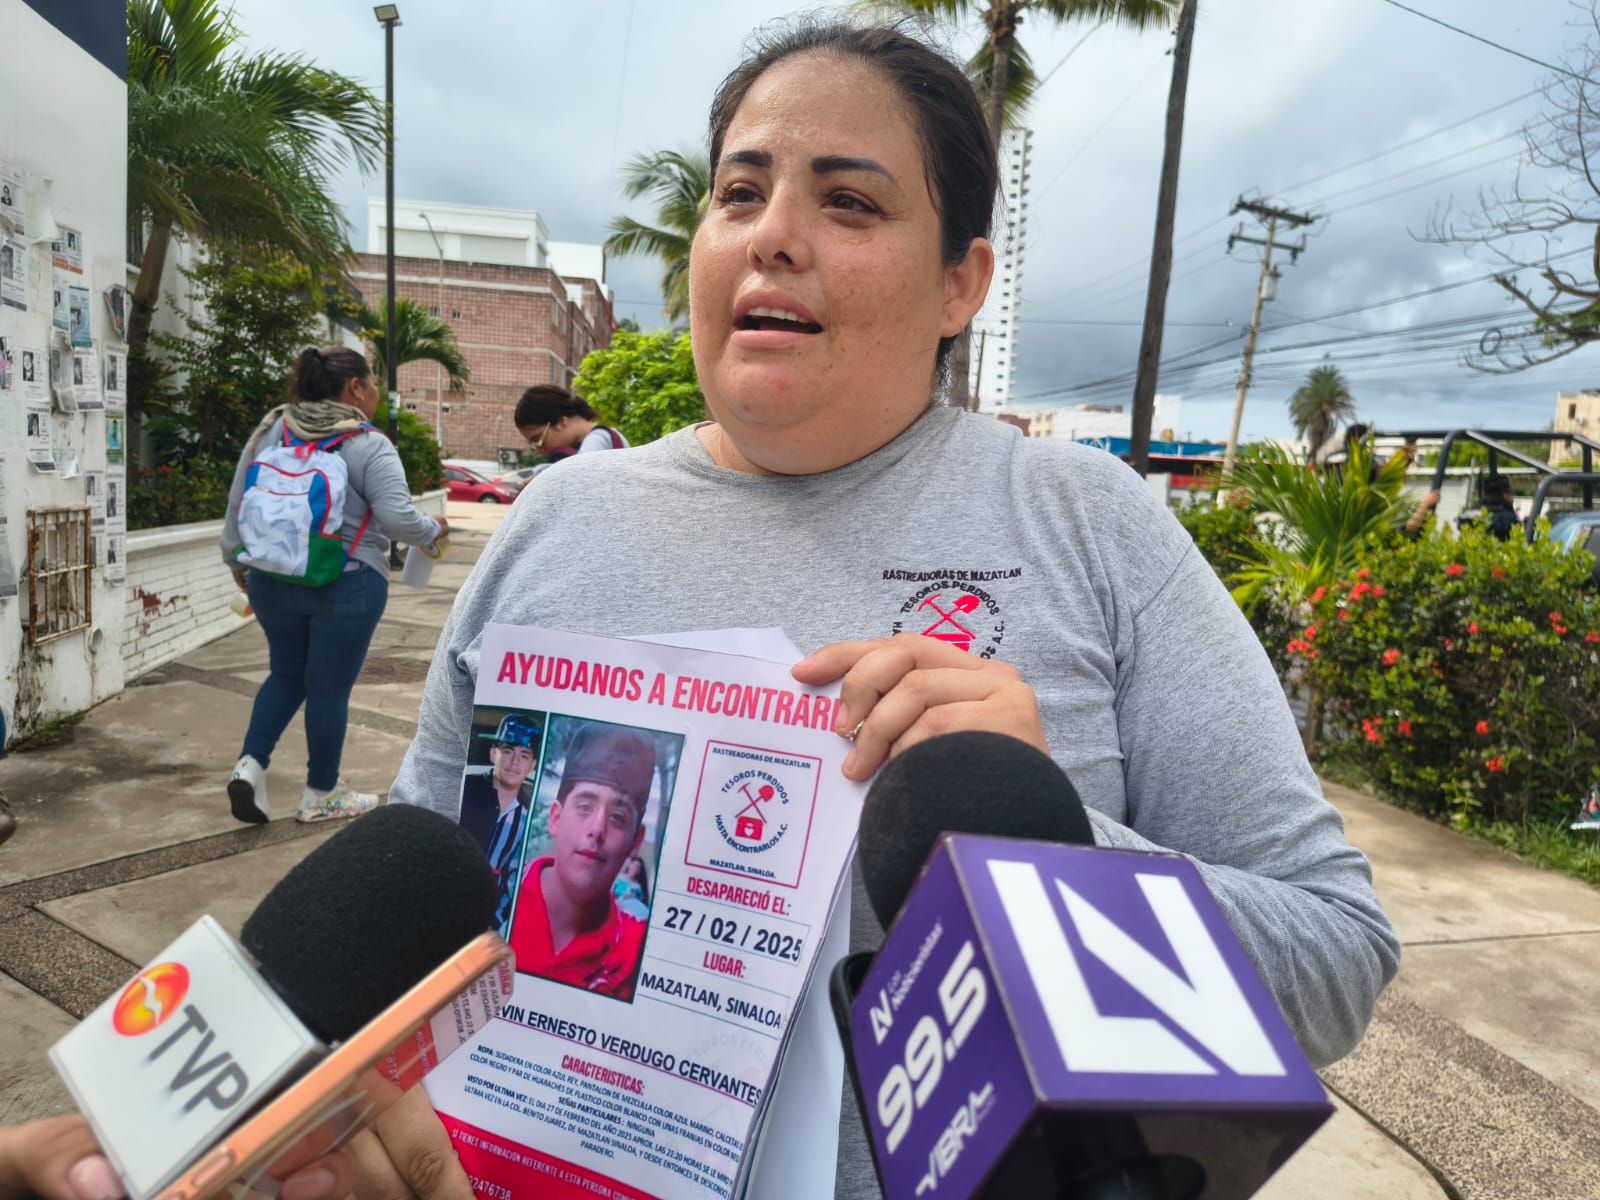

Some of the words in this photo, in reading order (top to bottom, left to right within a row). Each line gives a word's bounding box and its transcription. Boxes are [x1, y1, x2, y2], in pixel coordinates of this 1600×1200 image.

[883, 570, 955, 582] RASTREADORAS
[957, 570, 968, 581] DE
[970, 568, 1022, 581] MAZATLAN
[900, 581, 949, 614] TESOROS
[952, 581, 1000, 615] PERDIDOS
[497, 651, 644, 701] AYUDANOS
[647, 674, 665, 706] A
[712, 747, 764, 762] RASTREADORAS
[764, 755, 774, 764] DE
[774, 757, 811, 769] MAZATLAN
[721, 769, 756, 793] TESOROS
[757, 770, 789, 805] PERDIDOS
[715, 814, 729, 840] HASTA
[726, 835, 780, 854] ENCONTRARLOS
[687, 876, 770, 911] DESAPARECIÓ
[772, 896, 792, 916] EL:
[664, 906, 693, 931] 27
[695, 913, 706, 935] /
[710, 917, 737, 944] 02
[740, 925, 752, 946] /
[753, 929, 803, 962] 2025
[703, 951, 746, 978] LUGAR:
[641, 972, 722, 1012] MAZATLAN,
[725, 997, 782, 1029] SINALOA
[150, 1003, 249, 1114] TVP
[496, 1005, 525, 1023] VIN
[527, 1011, 597, 1047] ERNESTO
[604, 1036, 675, 1073] VERDUGO
[676, 1060, 762, 1104] CERVANTES
[562, 1055, 643, 1094] CARACTERISTICAS:
[877, 939, 988, 1155] 99.5
[470, 1053, 488, 1064] COLOR
[489, 1060, 508, 1072] NEGRO
[511, 1068, 523, 1077] PAR
[523, 1072, 531, 1080] DE
[532, 1076, 565, 1092] HUARACHES
[565, 1087, 574, 1095] DE
[574, 1090, 602, 1105] PLASTICO
[602, 1100, 623, 1113] COLOR
[623, 1107, 648, 1122] BLANCO
[648, 1116, 662, 1127] CON
[662, 1122, 679, 1134] UNAS
[704, 1139, 713, 1148] EN
[712, 1143, 731, 1156] COLOR
[495, 1051, 524, 1066] SUDADERA
[524, 1061, 532, 1069] EN
[532, 1064, 551, 1075] COLOR
[551, 1071, 566, 1081] AZUL
[567, 1076, 579, 1086] REY,
[580, 1080, 611, 1096] PANTALON
[612, 1091, 620, 1100] DE
[621, 1094, 652, 1111] MEZCLILLA
[653, 1106, 673, 1119] COLOR
[673, 1114, 688, 1125] AZUL
[464, 1085, 484, 1097] ULTIMA
[484, 1093, 494, 1102] VEZ
[494, 1096, 502, 1105] EN
[509, 1102, 521, 1112] COL.
[522, 1107, 544, 1121] BENITO
[544, 1116, 566, 1130] JUAREZ,
[567, 1123, 576, 1132] DE
[577, 1127, 610, 1144] MAZATLAN
[611, 1139, 638, 1156] SINALOA,
[643, 1151, 663, 1165] DESDE
[663, 1159, 692, 1179] ENTONCES
[693, 1173, 699, 1183] SE
[467, 1075, 483, 1086] VISTO
[483, 1080, 495, 1090] POR
[494, 1085, 515, 1098] ULTIMA
[516, 1093, 528, 1103] VEZ:
[528, 1097, 535, 1106] EL
[535, 1100, 546, 1109] DIA
[546, 1104, 554, 1112] 27
[554, 1107, 564, 1116] DE
[563, 1110, 590, 1126] FEBRERO
[590, 1119, 601, 1130] DEL
[602, 1124, 617, 1135] AÑO
[617, 1129, 632, 1141] 2025
[654, 1144, 666, 1154] LAS
[683, 1156, 702, 1171] HORAS
[702, 1165, 710, 1174] SE
[710, 1169, 717, 1177] LE
[558, 1096, 577, 1108] SEÑAS
[577, 1103, 621, 1124] PARTICULARES
[626, 1120, 655, 1137] NINGUNA
[915, 1082, 994, 1197] VIBRA
[459, 1131, 479, 1146] TIENES
[522, 1156, 557, 1176] REFERENTE
[565, 1172, 581, 1185] ESTA
[582, 1178, 612, 1197] PERSONA
[580, 1140, 614, 1158] PARADERO.
